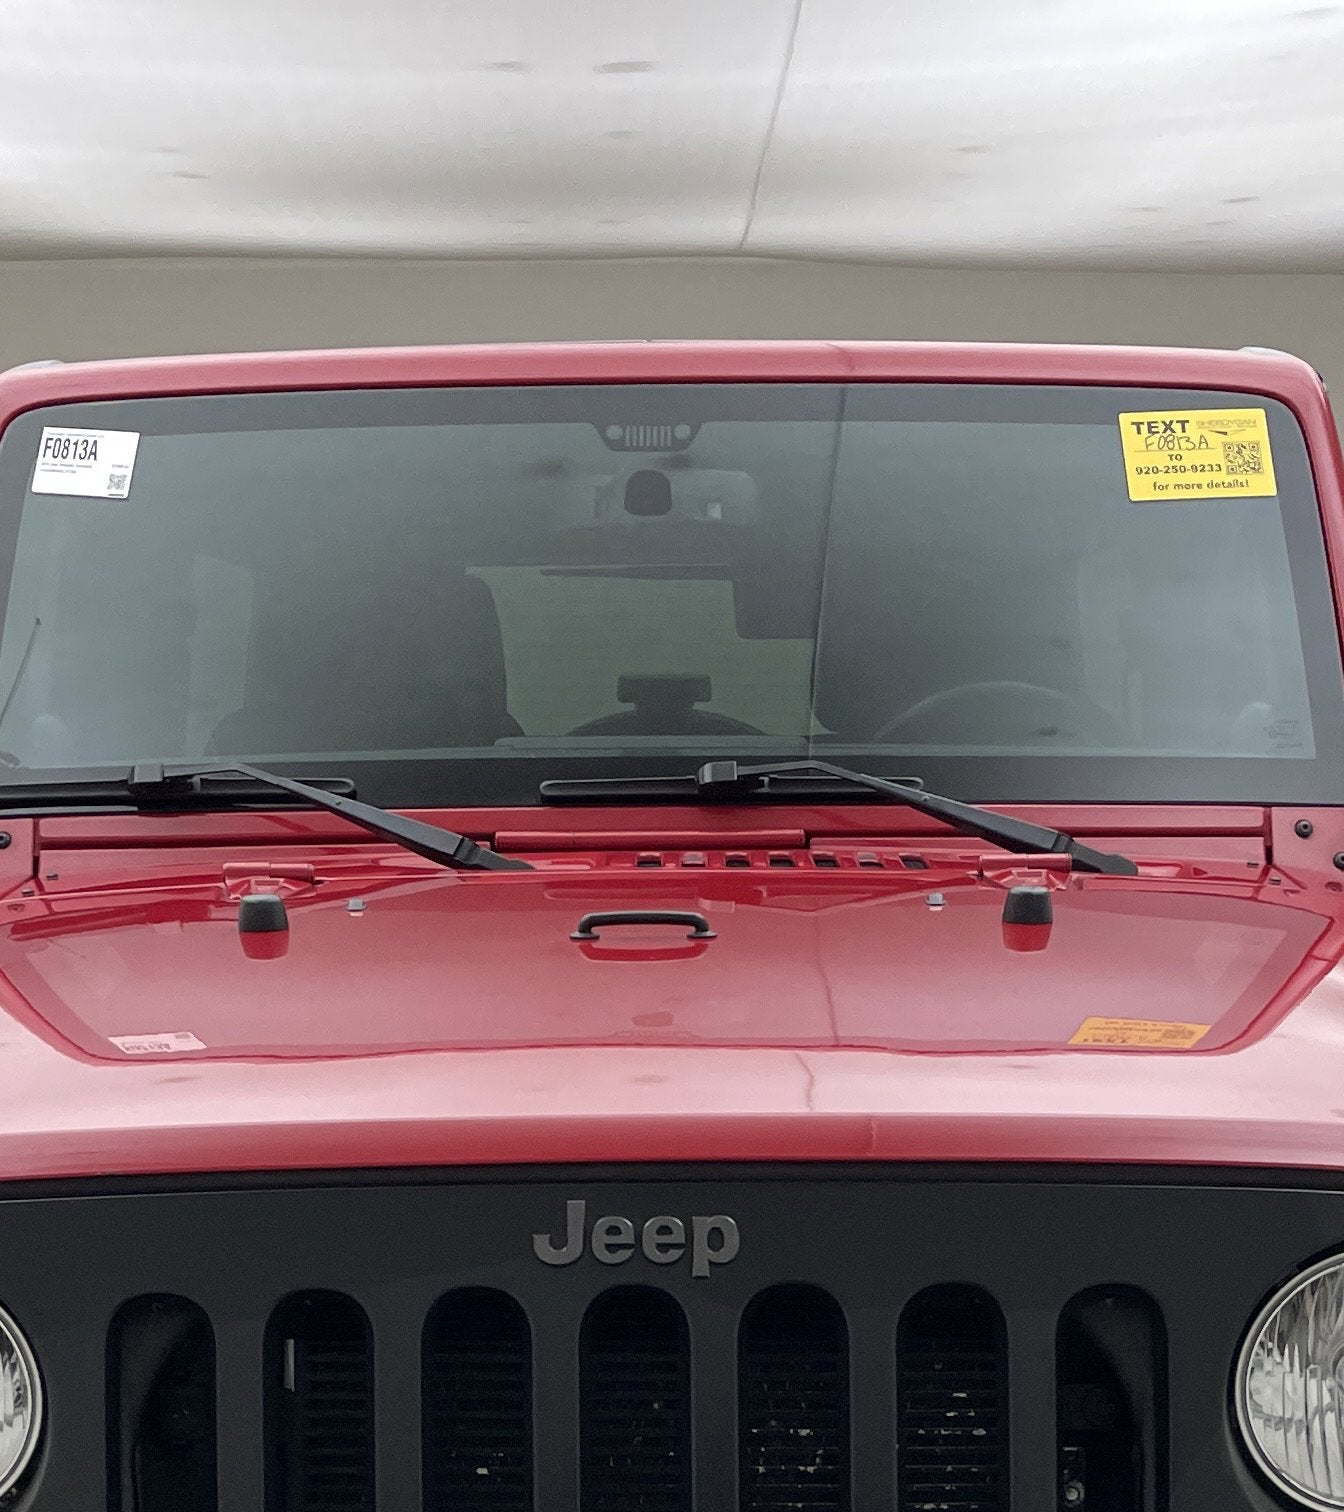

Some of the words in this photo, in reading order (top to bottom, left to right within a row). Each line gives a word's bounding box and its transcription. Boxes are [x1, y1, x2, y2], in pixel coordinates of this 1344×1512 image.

[1131, 419, 1190, 435] TEXT
[42, 437, 98, 461] F0813A
[1145, 433, 1210, 451] F0813A
[1167, 453, 1183, 462] TO
[1135, 463, 1222, 475] 920-250-9233
[1153, 481, 1169, 491] for
[1207, 479, 1249, 489] details!
[532, 1200, 740, 1278] Jeep
